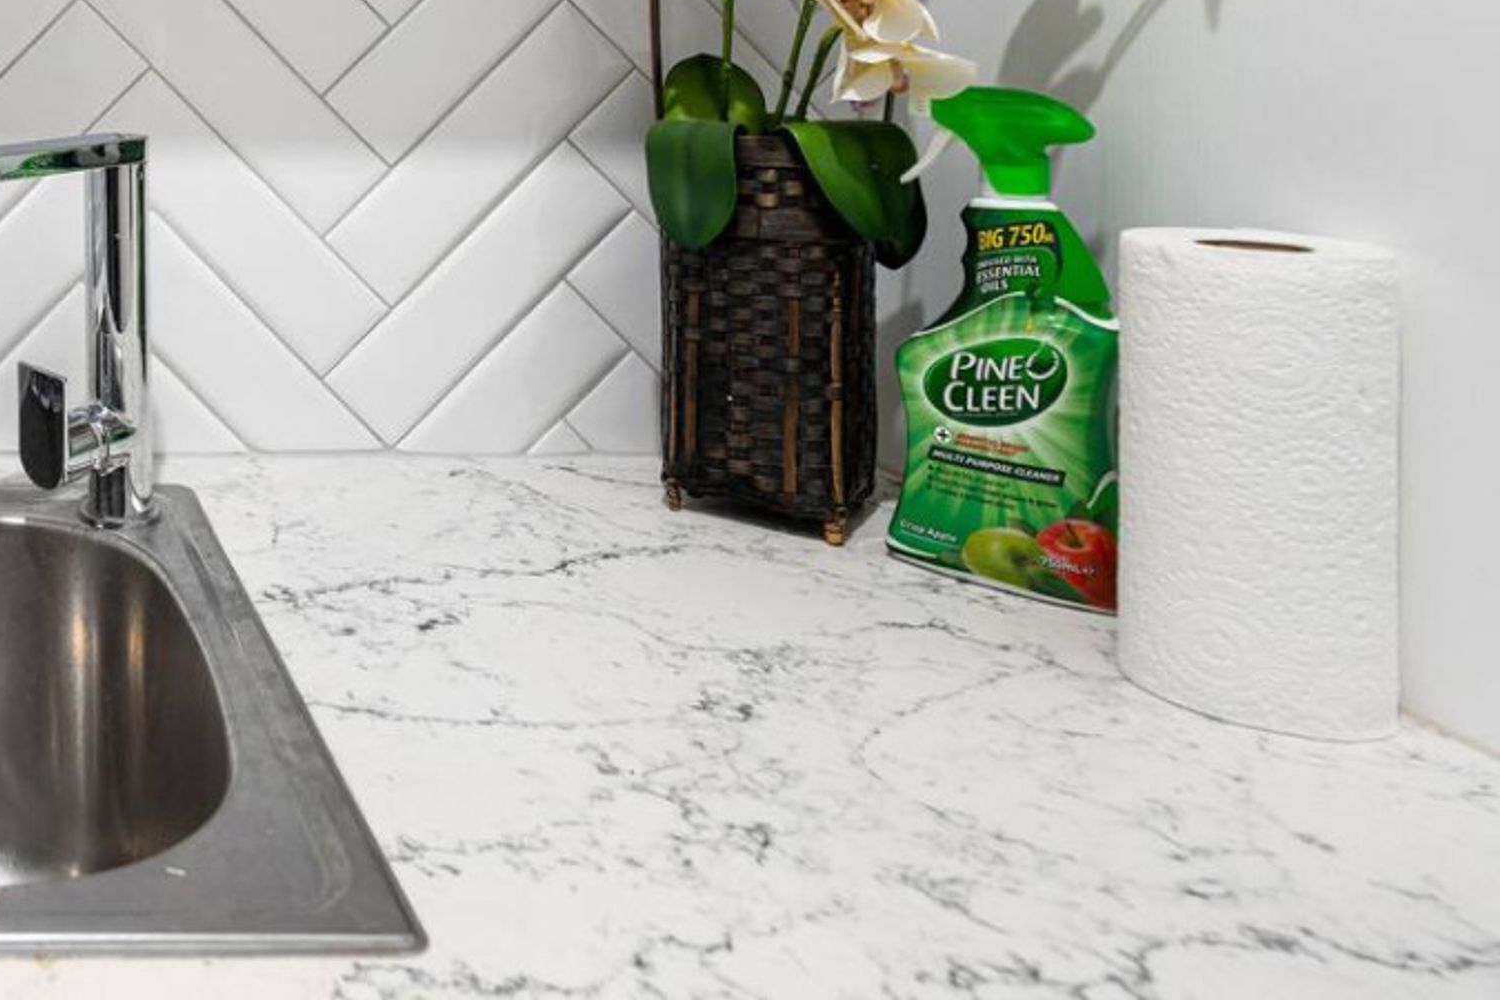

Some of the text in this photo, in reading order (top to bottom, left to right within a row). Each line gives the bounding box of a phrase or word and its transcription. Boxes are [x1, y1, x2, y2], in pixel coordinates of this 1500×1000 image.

[978, 227, 1004, 250] BIG
[976, 264, 1041, 284] ESSENTIAL
[981, 279, 1008, 293] OILS
[950, 351, 1024, 381] PINE
[943, 380, 1039, 412] CLEEN
[965, 455, 1014, 474] PURPOSE
[1014, 465, 1061, 482] CLEANER
[927, 526, 957, 542] Apple
